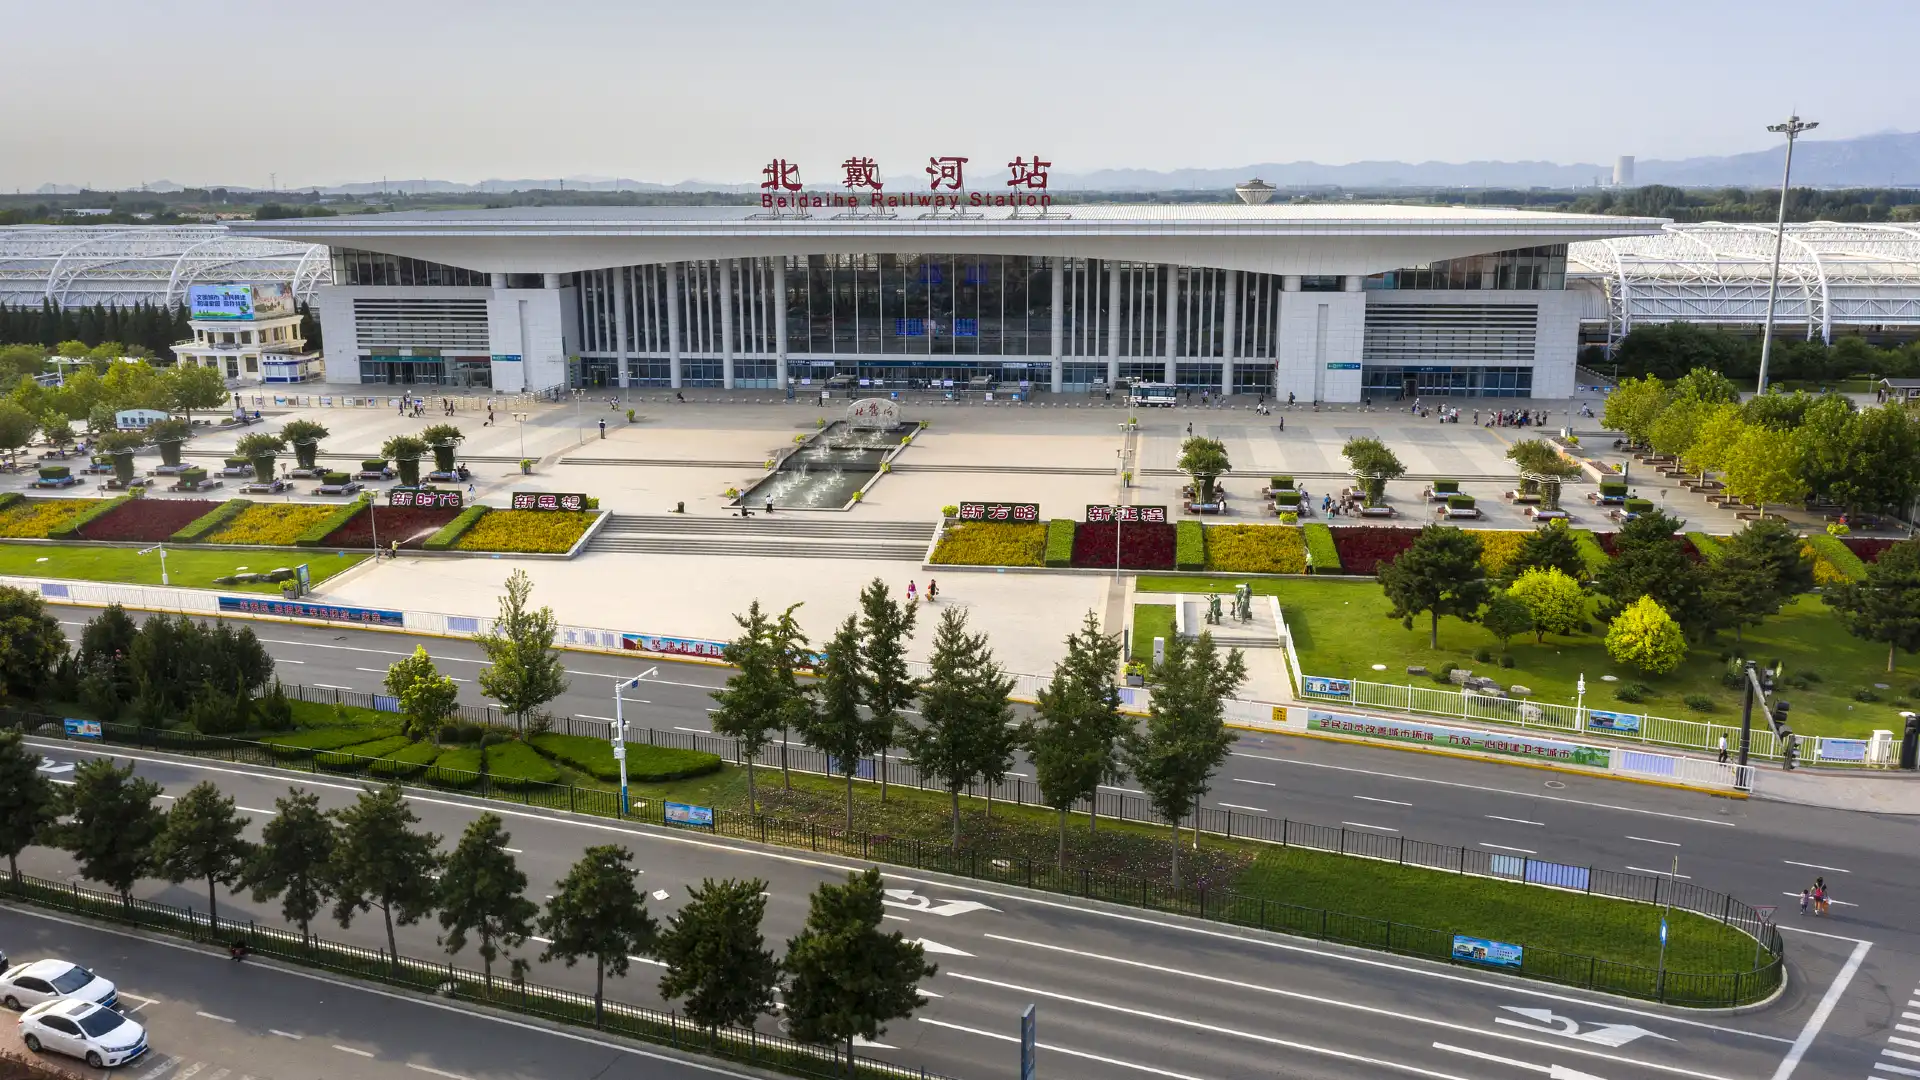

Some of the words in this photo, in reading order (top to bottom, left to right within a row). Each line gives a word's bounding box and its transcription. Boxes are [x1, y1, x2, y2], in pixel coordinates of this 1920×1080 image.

[761, 155, 1052, 191] 北戴河站
[761, 192, 857, 208] Beidaihe
[872, 191, 960, 210] Railway
[970, 192, 1052, 208] Station
[855, 401, 893, 417] 北戴河
[391, 491, 460, 507] 新时代
[514, 493, 582, 511] 新思想
[962, 502, 1037, 520] 新方略
[1088, 506, 1164, 522] 新征程
[1319, 718, 1435, 741] 全民动员改善城市环境
[1448, 733, 1571, 759] 万众一心创建卫生城市
